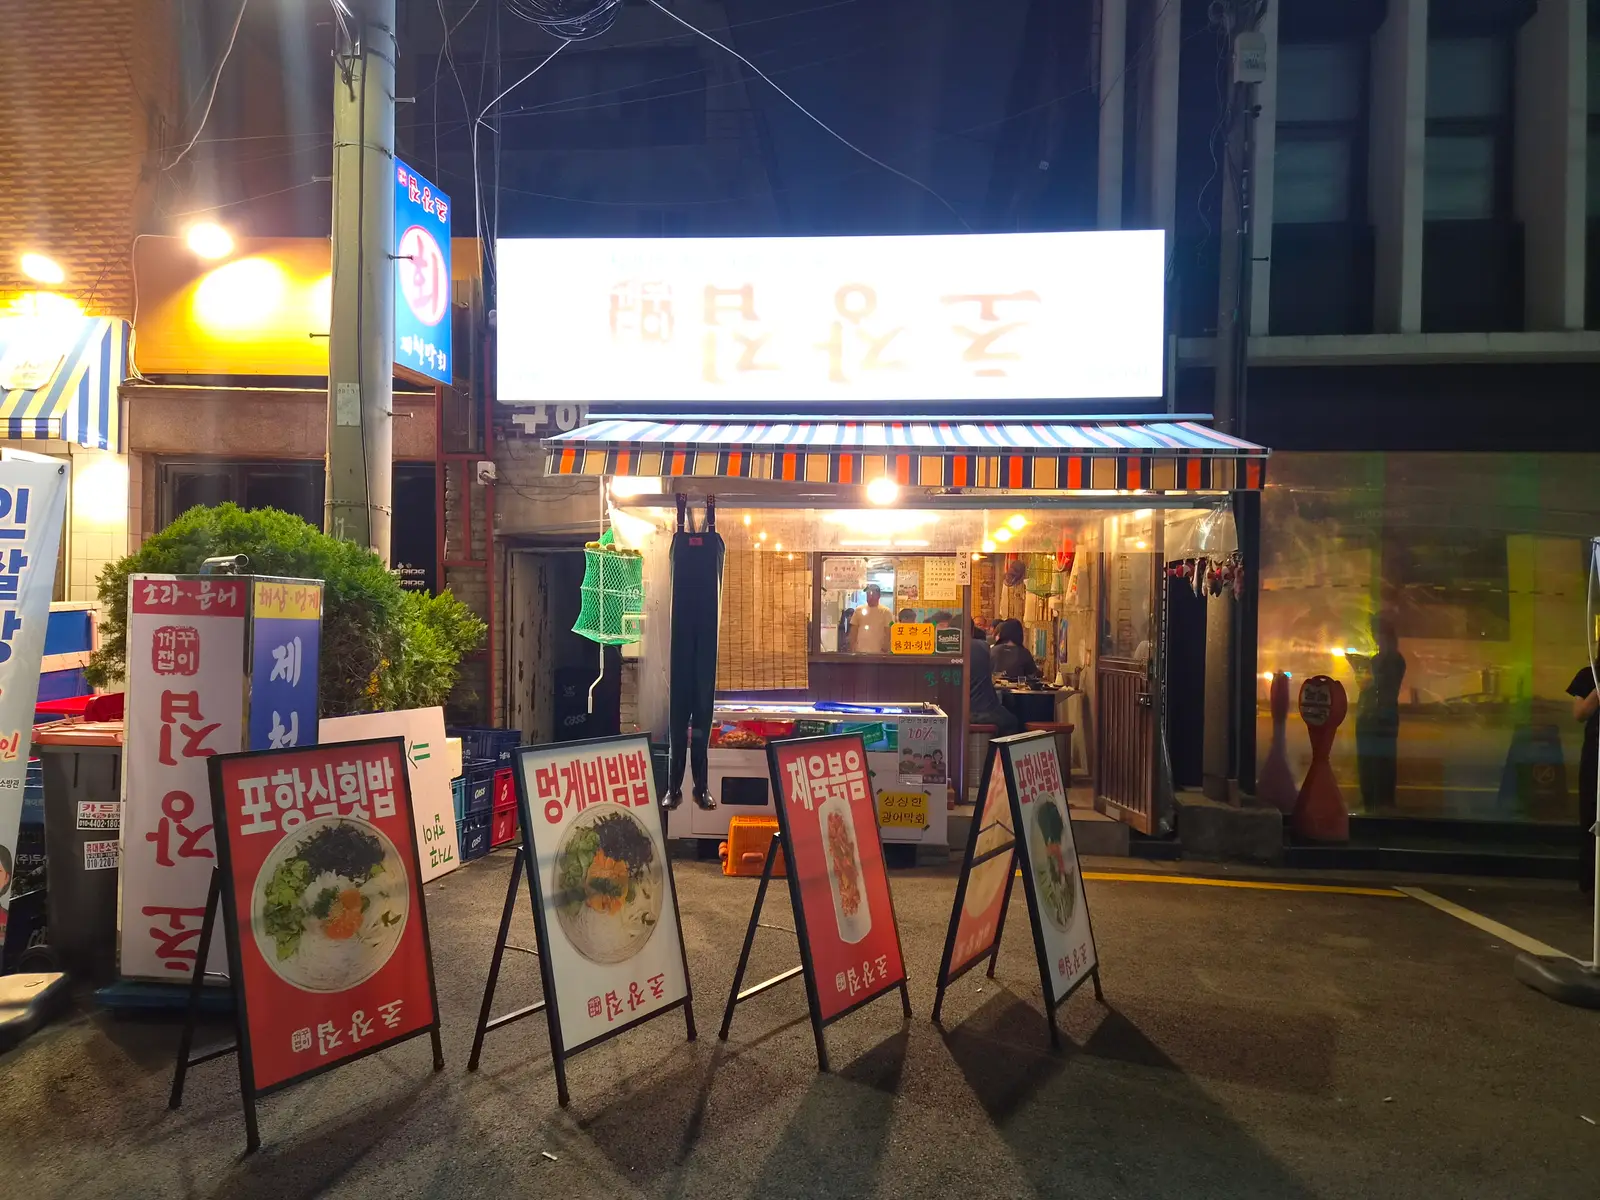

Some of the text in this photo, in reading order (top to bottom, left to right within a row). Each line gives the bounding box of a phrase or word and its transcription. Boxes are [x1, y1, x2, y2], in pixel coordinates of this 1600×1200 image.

[411, 234, 438, 317] 회
[237, 756, 397, 837] 포항식횟밥
[534, 750, 650, 825] 멍게비빔밥
[786, 750, 867, 811] 제육볶음
